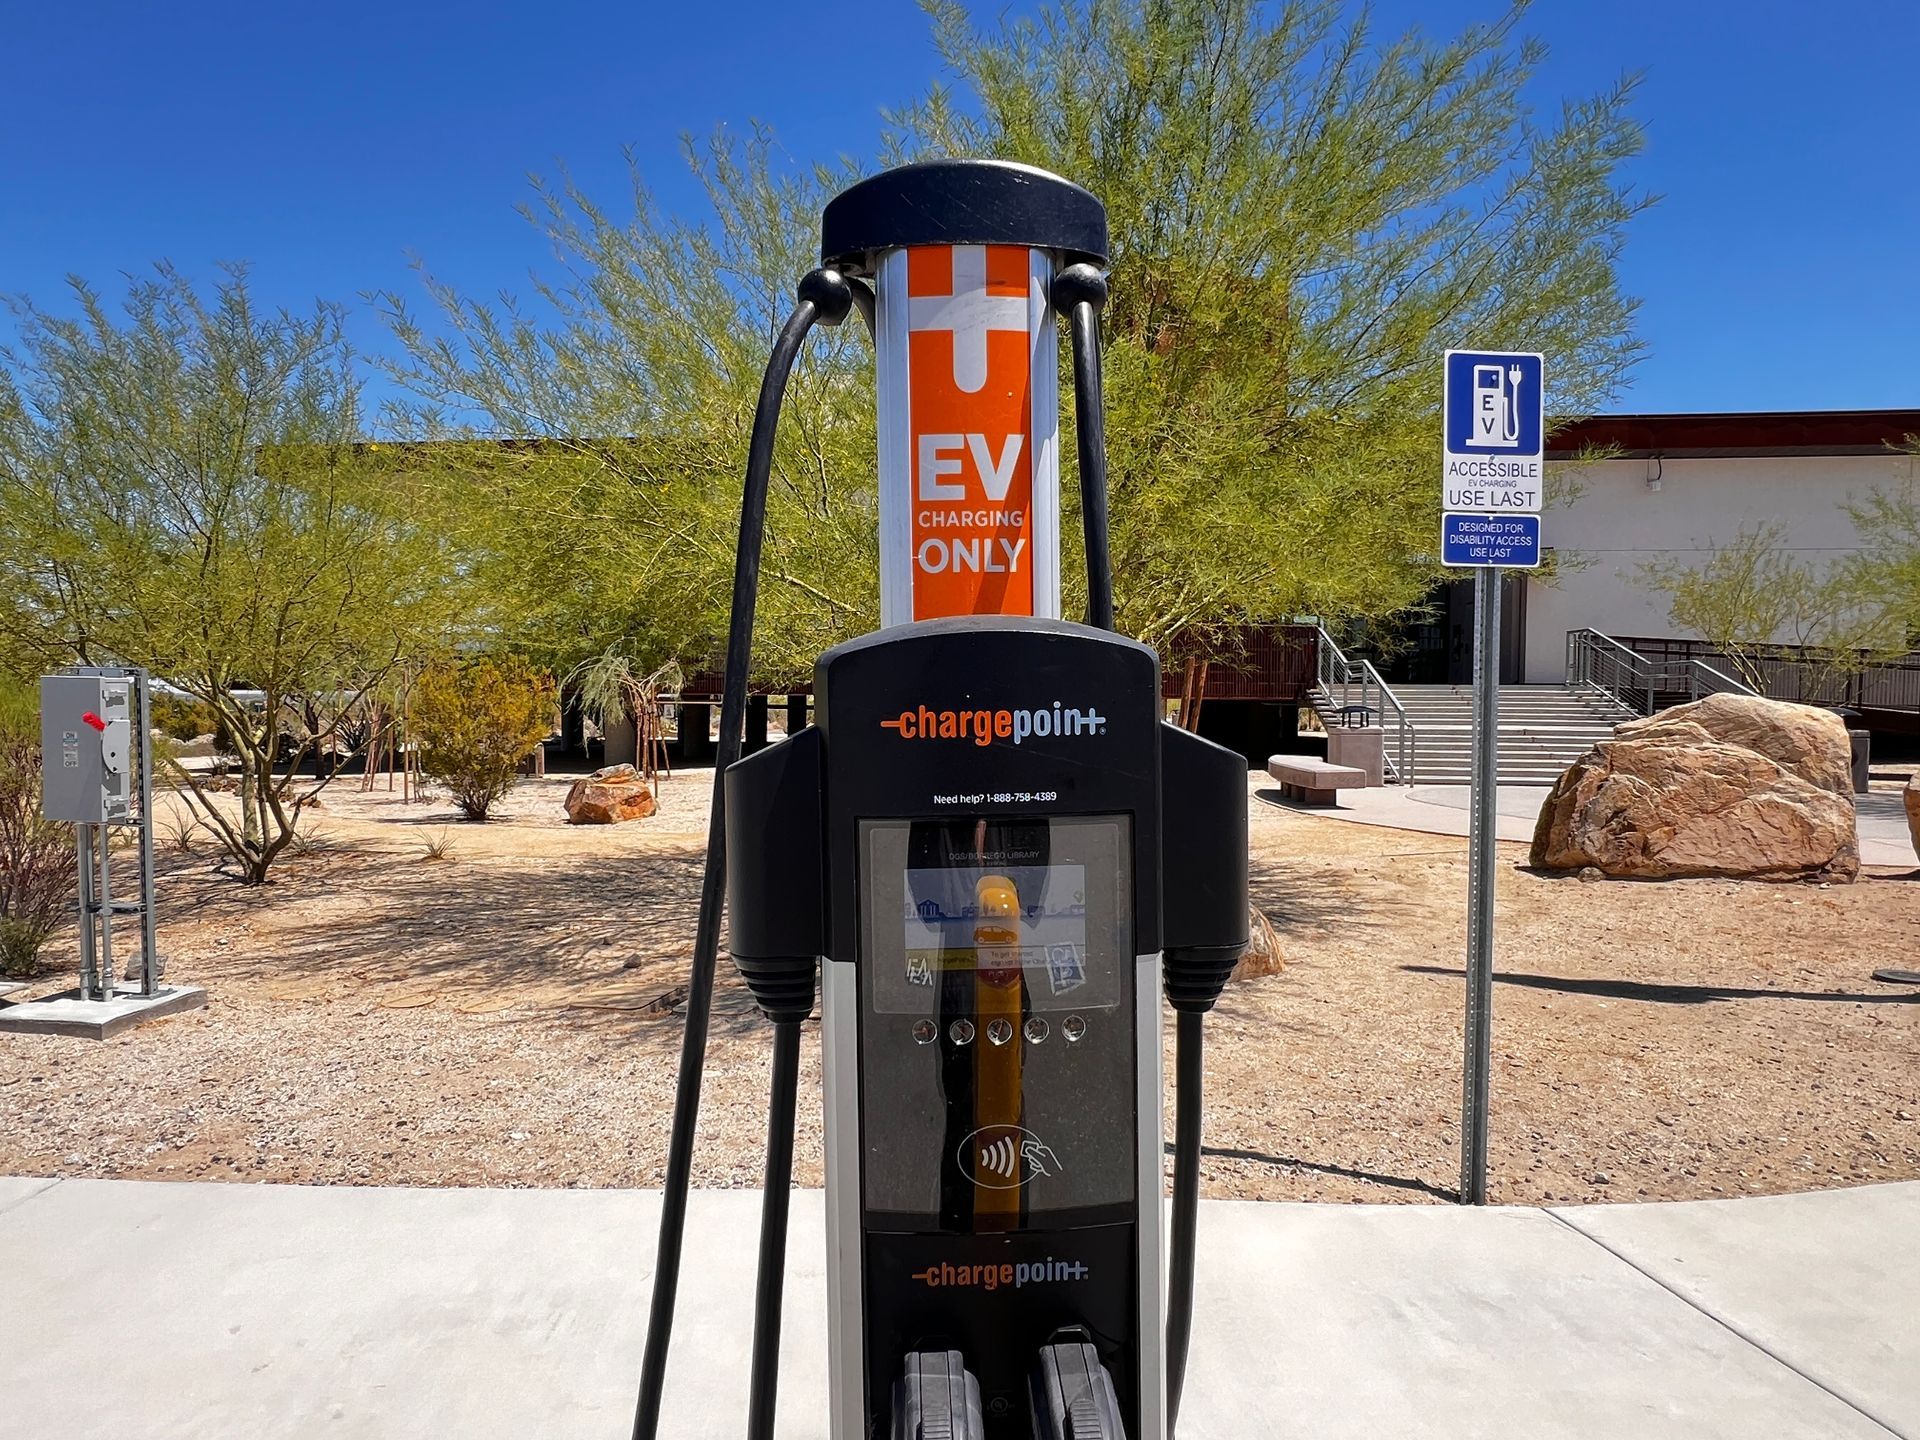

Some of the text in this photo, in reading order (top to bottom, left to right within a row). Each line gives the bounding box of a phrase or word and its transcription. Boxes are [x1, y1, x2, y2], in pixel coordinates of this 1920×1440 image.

[918, 433, 1025, 502] EV
[1449, 461, 1538, 478] ACCESSIBLE
[1468, 479, 1517, 488] EV CHARGING
[1450, 490, 1536, 507] USE LAST
[918, 510, 1023, 528] CHARGING
[1458, 522, 1524, 534] DESIGNED FOR
[1450, 534, 1533, 547] DISABILITY ACCESS
[918, 538, 1026, 574] ONLY
[1469, 547, 1511, 558] USE LAST
[881, 701, 1107, 746] chargepoint
[934, 792, 1057, 805] Need help? 1-888-758-4389
[1007, 850, 1040, 859] LIBRARY
[912, 1256, 1089, 1290] chargepoint
